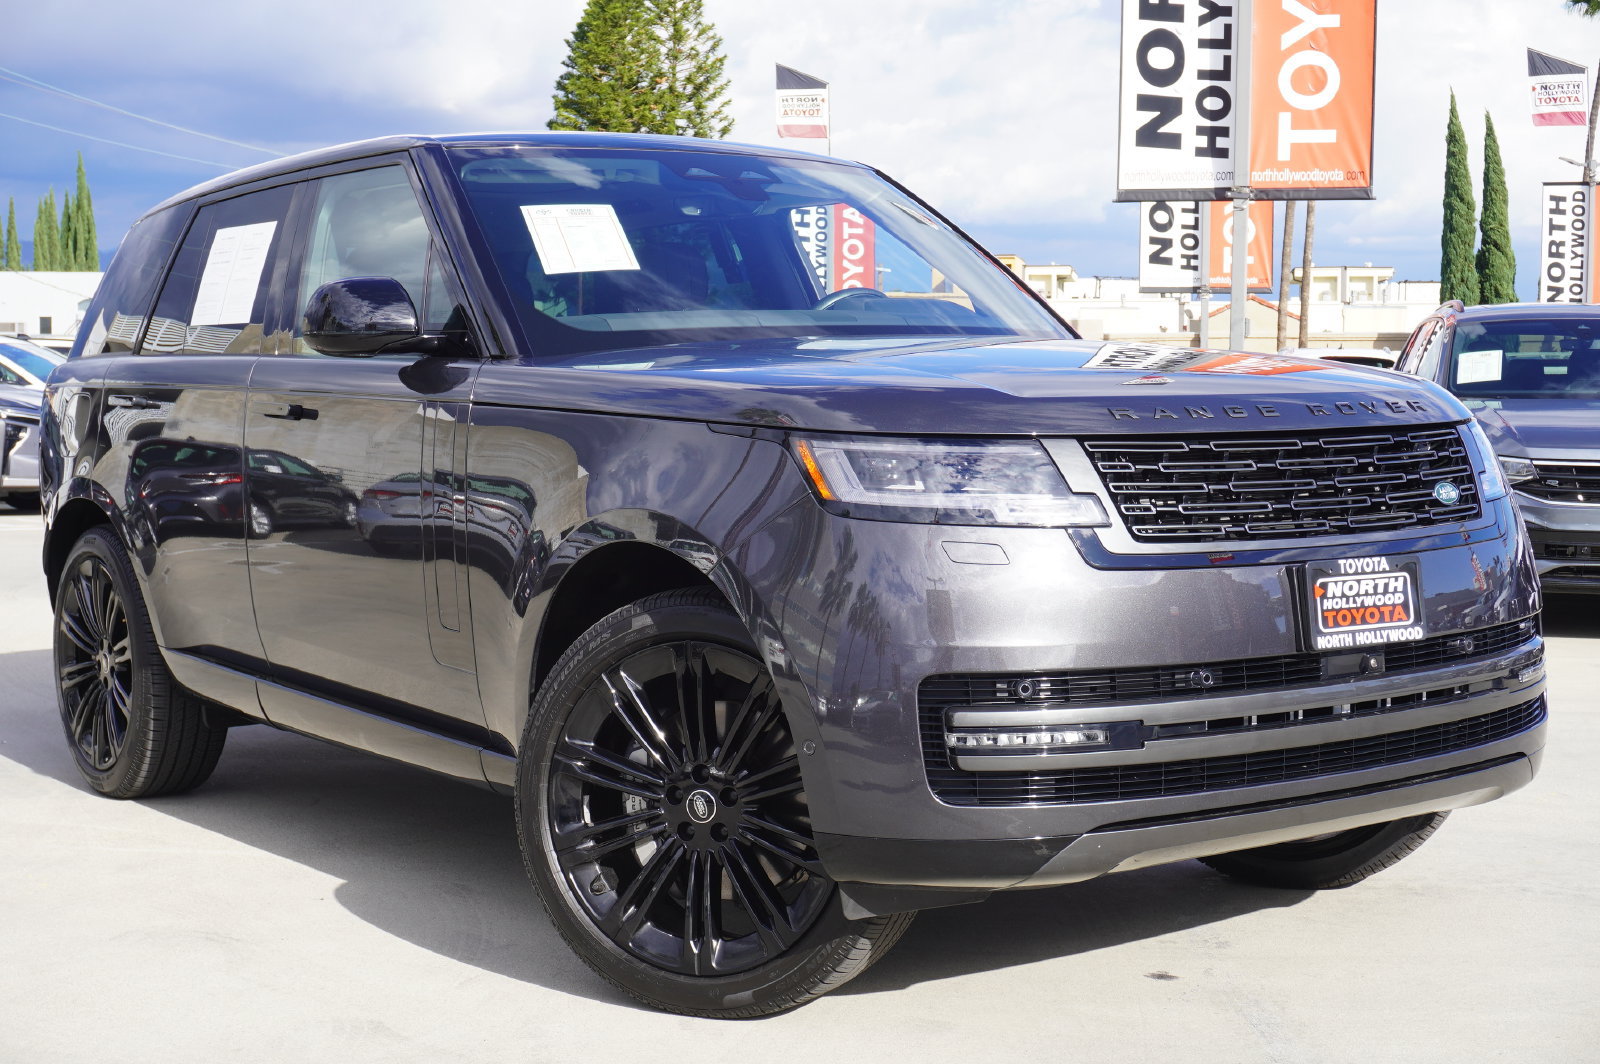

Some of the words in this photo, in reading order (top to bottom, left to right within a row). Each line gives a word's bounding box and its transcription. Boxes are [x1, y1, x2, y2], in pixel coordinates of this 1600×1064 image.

[1277, 0, 1341, 162] TOY
[1540, 83, 1581, 91] NORTH
[1537, 96, 1581, 104] TOYOTA
[1251, 168, 1365, 184] northhollywoodtoyota.com
[1106, 404, 1282, 421] RANGE
[1307, 399, 1429, 417] ROVER
[1338, 557, 1390, 574] TOYOTA
[1326, 577, 1405, 598] NORTH
[1322, 592, 1405, 610] HOLLYWOOD
[1323, 605, 1409, 628] TOYOTA
[1317, 632, 1353, 649] NORTH
[1355, 626, 1424, 645] HOLLYWOOD
